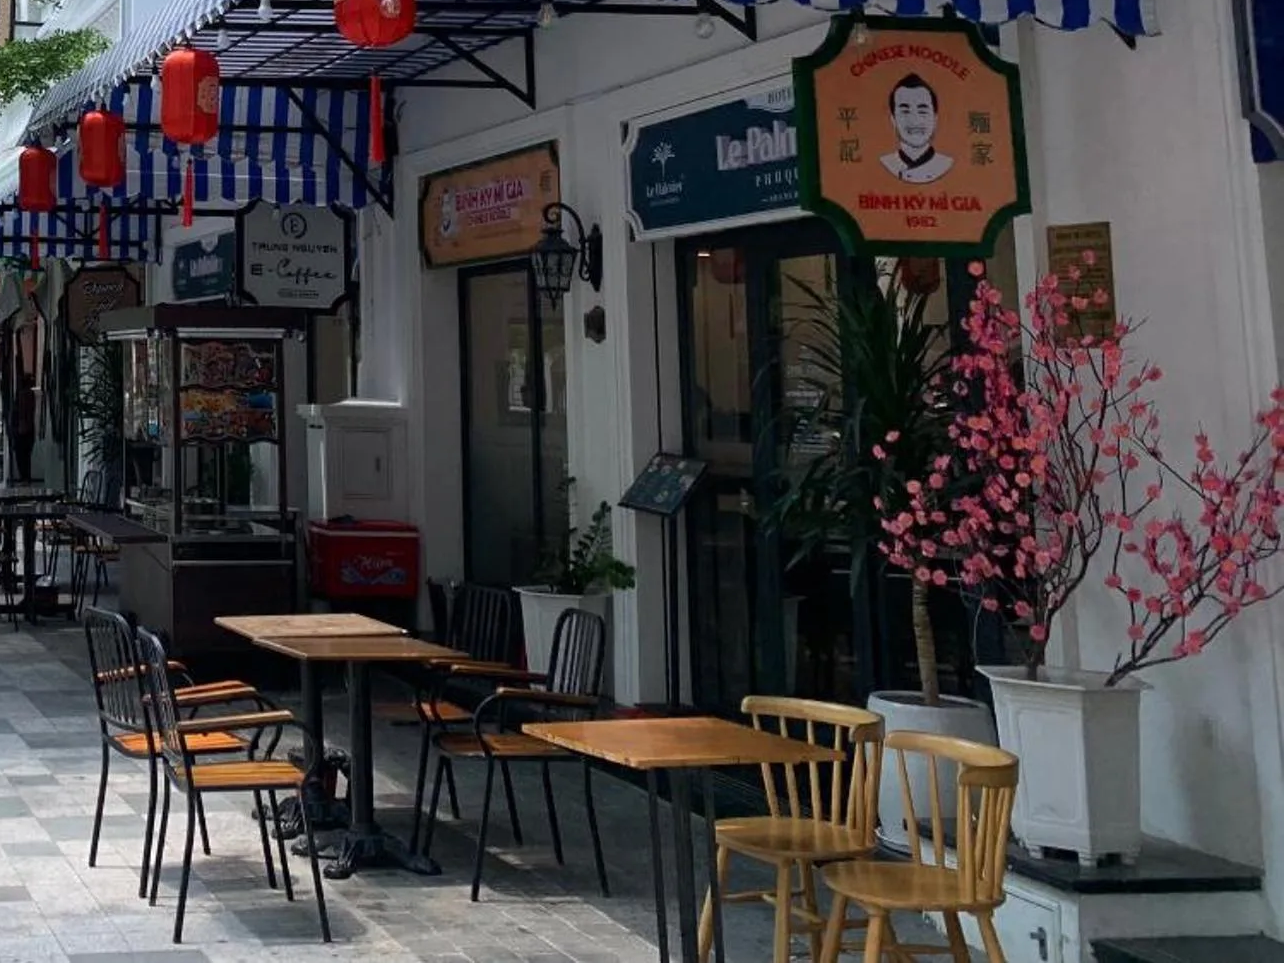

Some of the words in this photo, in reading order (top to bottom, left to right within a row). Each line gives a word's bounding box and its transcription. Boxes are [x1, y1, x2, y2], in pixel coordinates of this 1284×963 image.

[850, 45, 905, 76] CHINESE
[908, 45, 972, 81] NOODLE
[715, 134, 747, 171] Le
[950, 196, 983, 211] GIA
